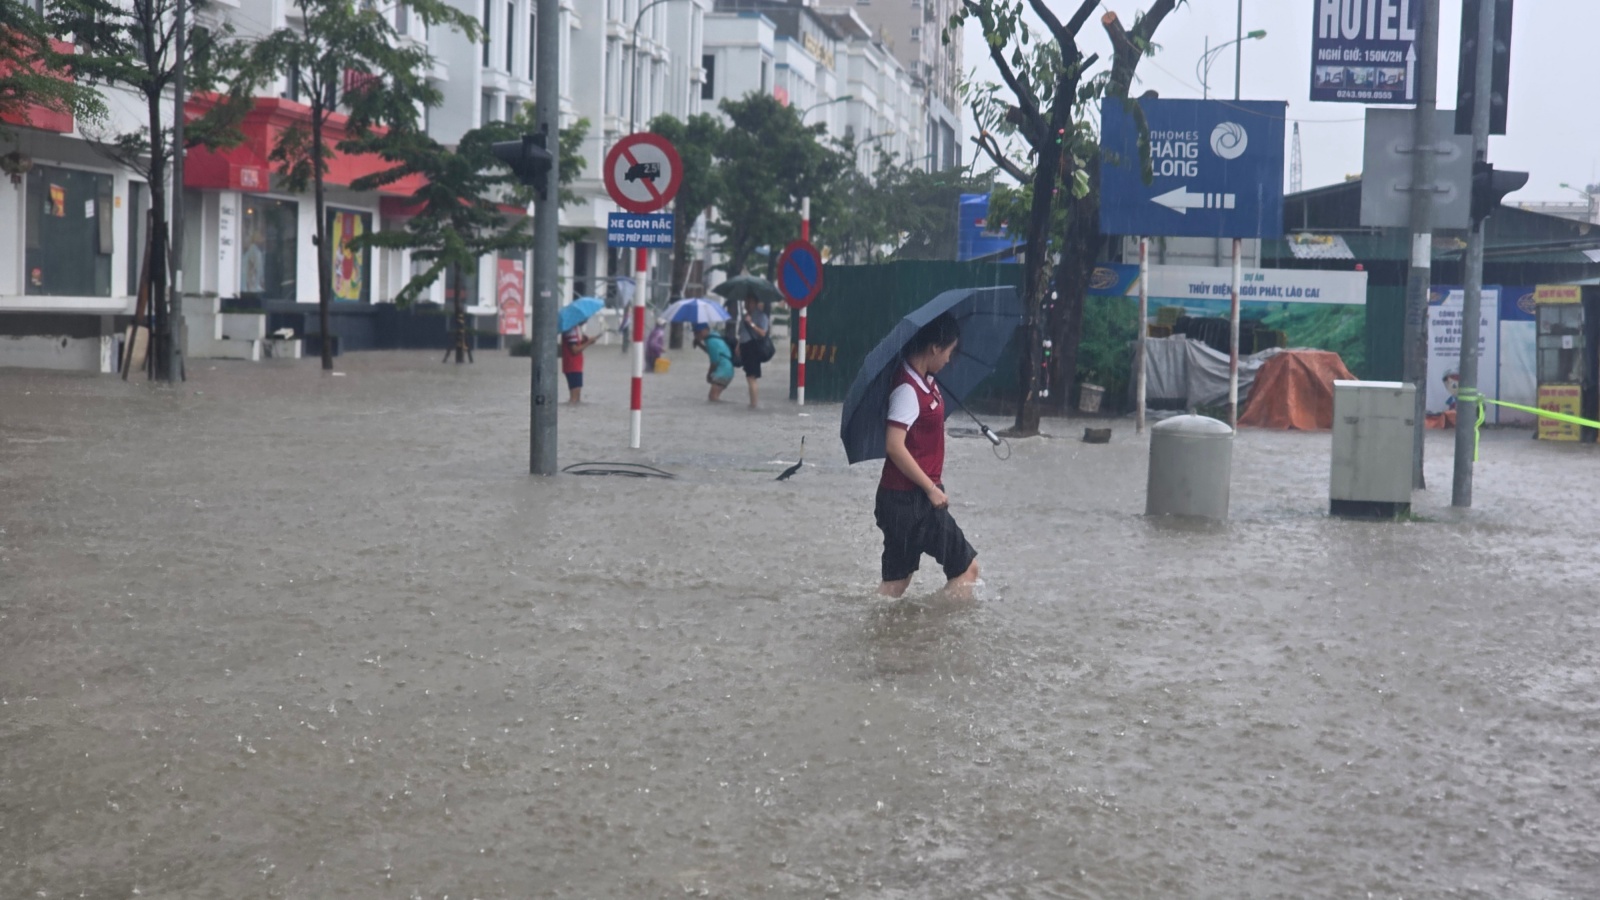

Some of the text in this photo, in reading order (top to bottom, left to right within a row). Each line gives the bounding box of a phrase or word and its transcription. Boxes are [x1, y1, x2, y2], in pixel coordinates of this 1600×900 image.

[1319, 0, 1416, 40] HOTEL
[1365, 50, 1402, 62] 150K/2H
[1150, 130, 1199, 140] NHOMES
[610, 219, 625, 228] XE
[626, 219, 650, 229] GOM
